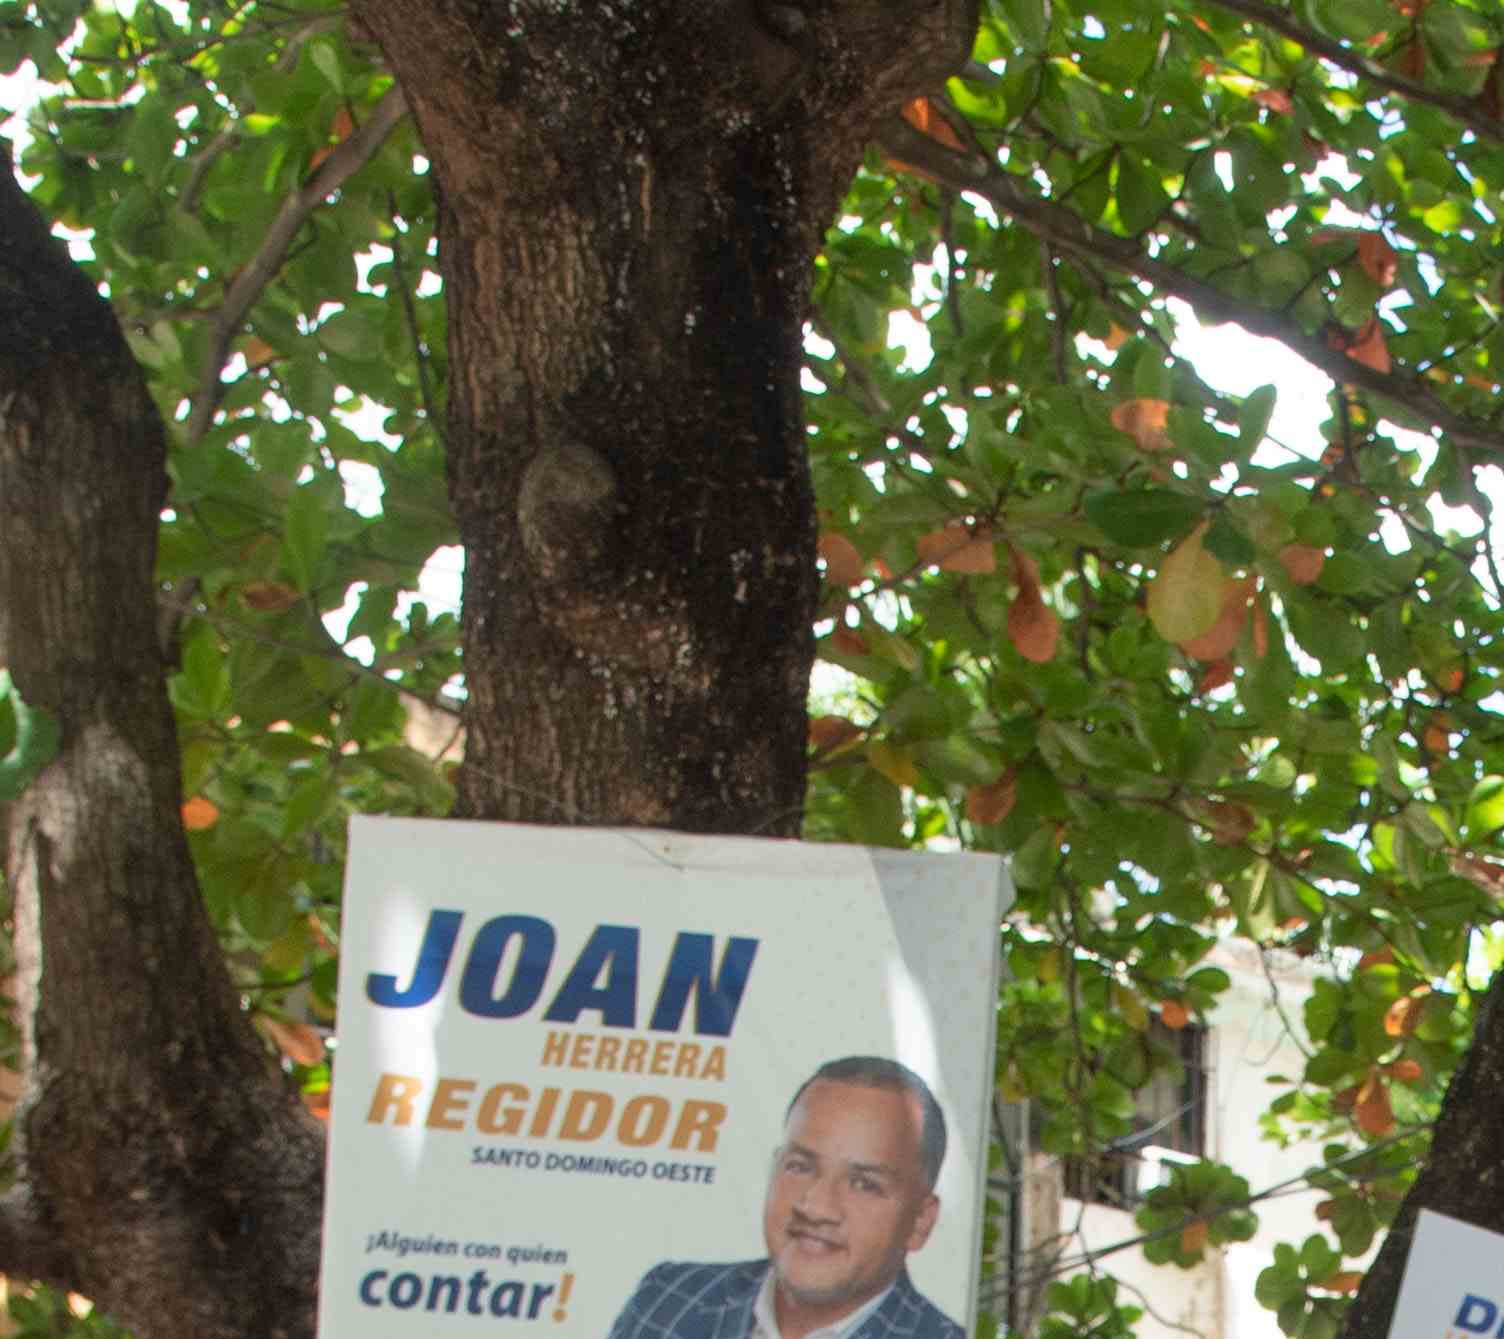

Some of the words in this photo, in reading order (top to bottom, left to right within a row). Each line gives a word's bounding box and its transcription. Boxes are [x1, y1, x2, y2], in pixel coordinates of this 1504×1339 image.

[366, 909, 759, 1038] JOAN
[540, 1031, 728, 1081] HERRERA
[365, 1073, 728, 1153] REGIDOR
[471, 1146, 541, 1170] SANTO
[545, 1152, 647, 1179] DOMINGO
[652, 1162, 717, 1185] OESTE
[463, 1240, 501, 1260] con
[506, 1243, 568, 1266] quien
[358, 1267, 576, 1323] contar!
